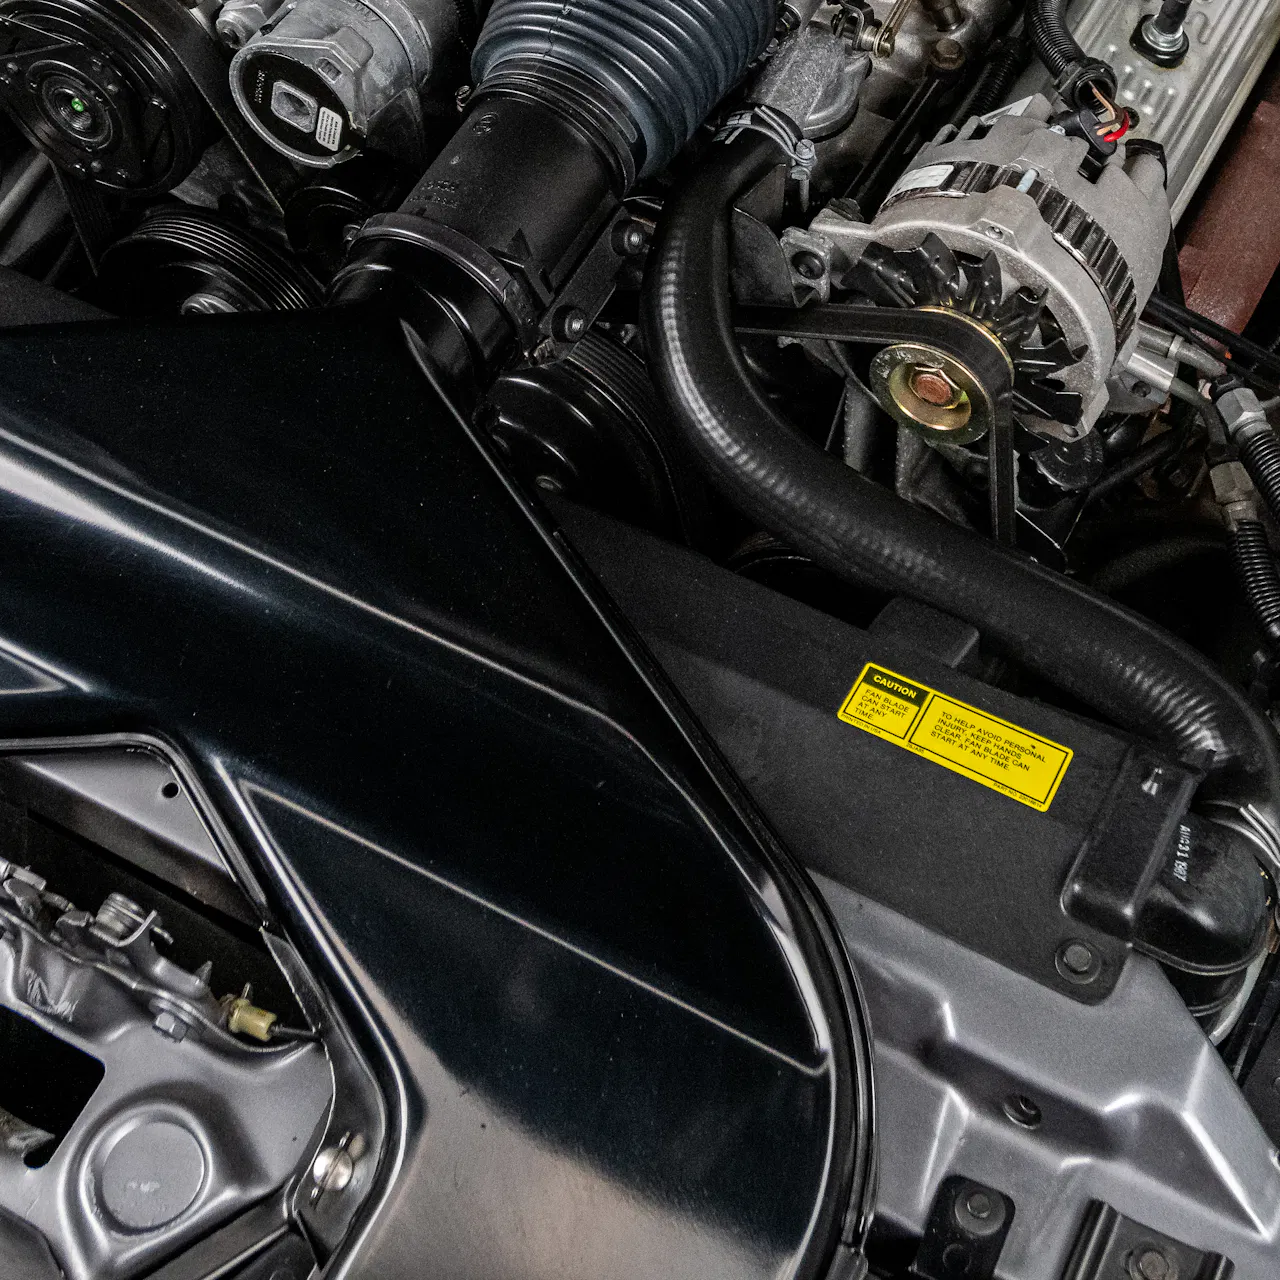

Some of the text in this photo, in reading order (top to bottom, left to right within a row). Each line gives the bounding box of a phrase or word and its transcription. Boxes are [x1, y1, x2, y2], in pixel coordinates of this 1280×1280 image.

[873, 674, 917, 699] CAUTION
[858, 701, 889, 718] AT ANY
[861, 695, 907, 719] CAN START
[865, 689, 910, 713] FAN BLADE
[841, 713, 863, 726] PRINTED
[870, 726, 881, 735] USA
[854, 707, 875, 721] TIME.
[941, 711, 1047, 763] TO HELP AVOID PERSONAL
[970, 732, 992, 745] KEEP
[993, 743, 1022, 760] HANDS
[930, 731, 1011, 771] START AT ANY TIME.
[964, 737, 982, 750] FAN
[983, 747, 1010, 763] BLADE
[1012, 759, 1031, 772] CAN
[993, 782, 1008, 792] PART
